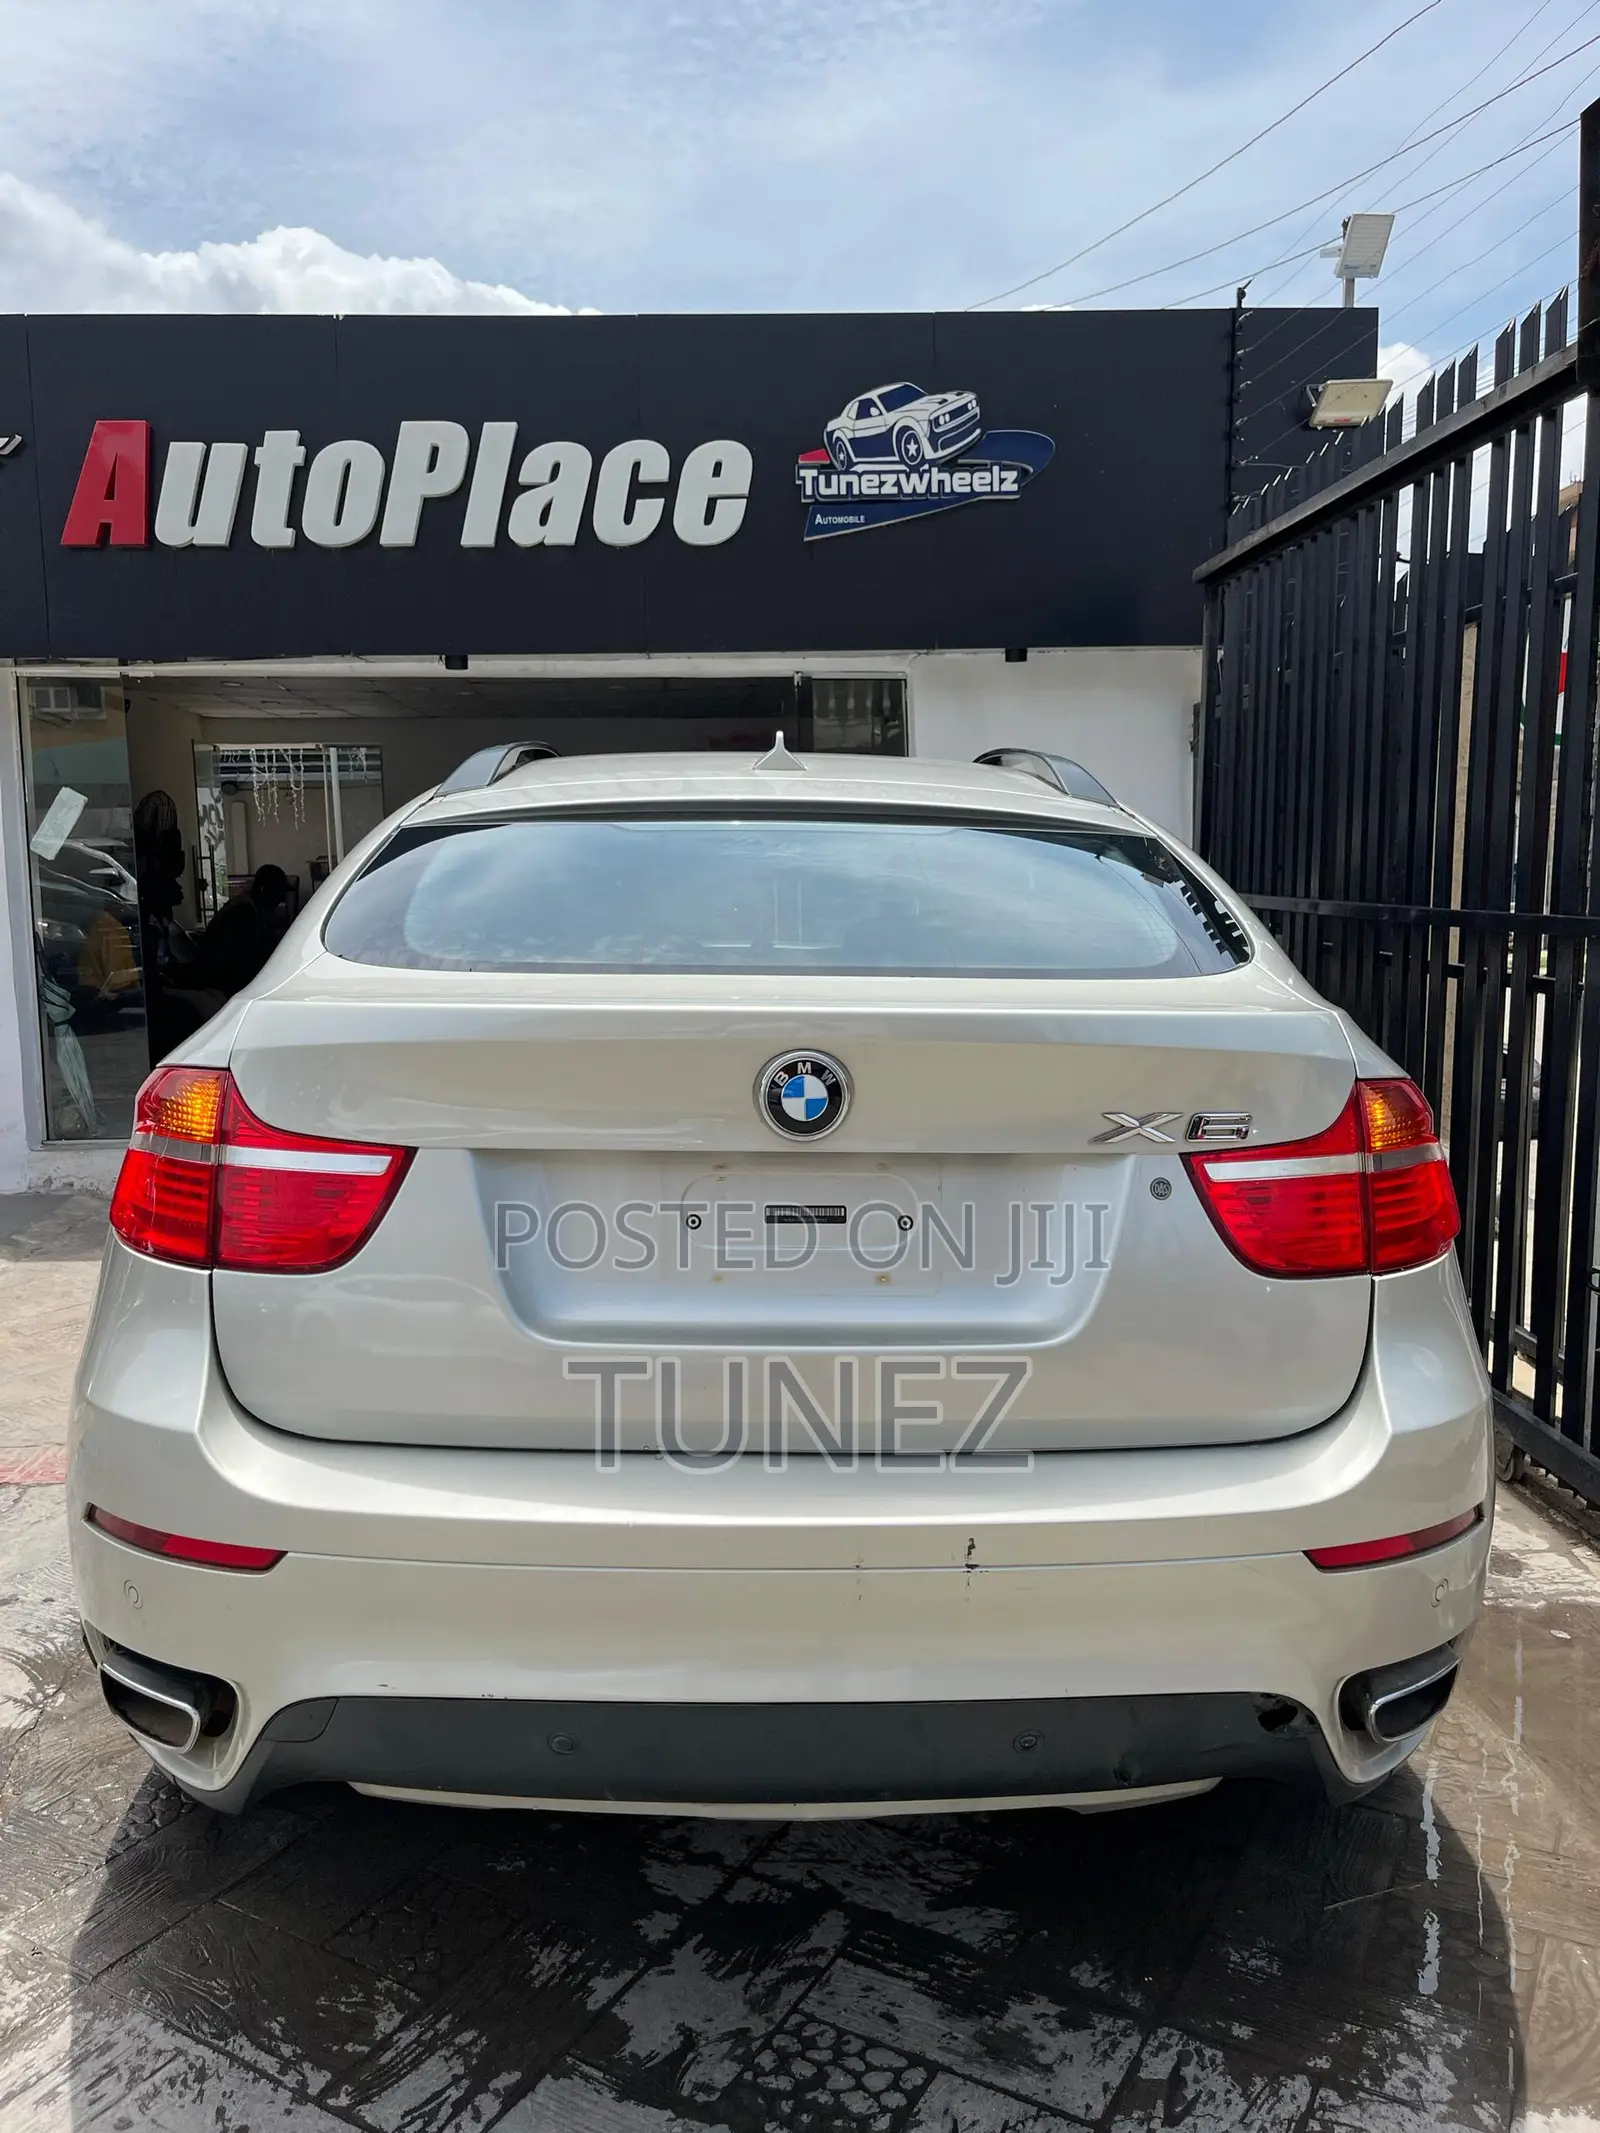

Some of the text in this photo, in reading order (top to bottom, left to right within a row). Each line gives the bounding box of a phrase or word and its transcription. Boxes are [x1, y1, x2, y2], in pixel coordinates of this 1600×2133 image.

[60, 419, 753, 548] AutoPlace
[800, 465, 1018, 496] Tunezwheelz
[773, 1061, 837, 1087] BMW
[1089, 1112, 1252, 1143] X6
